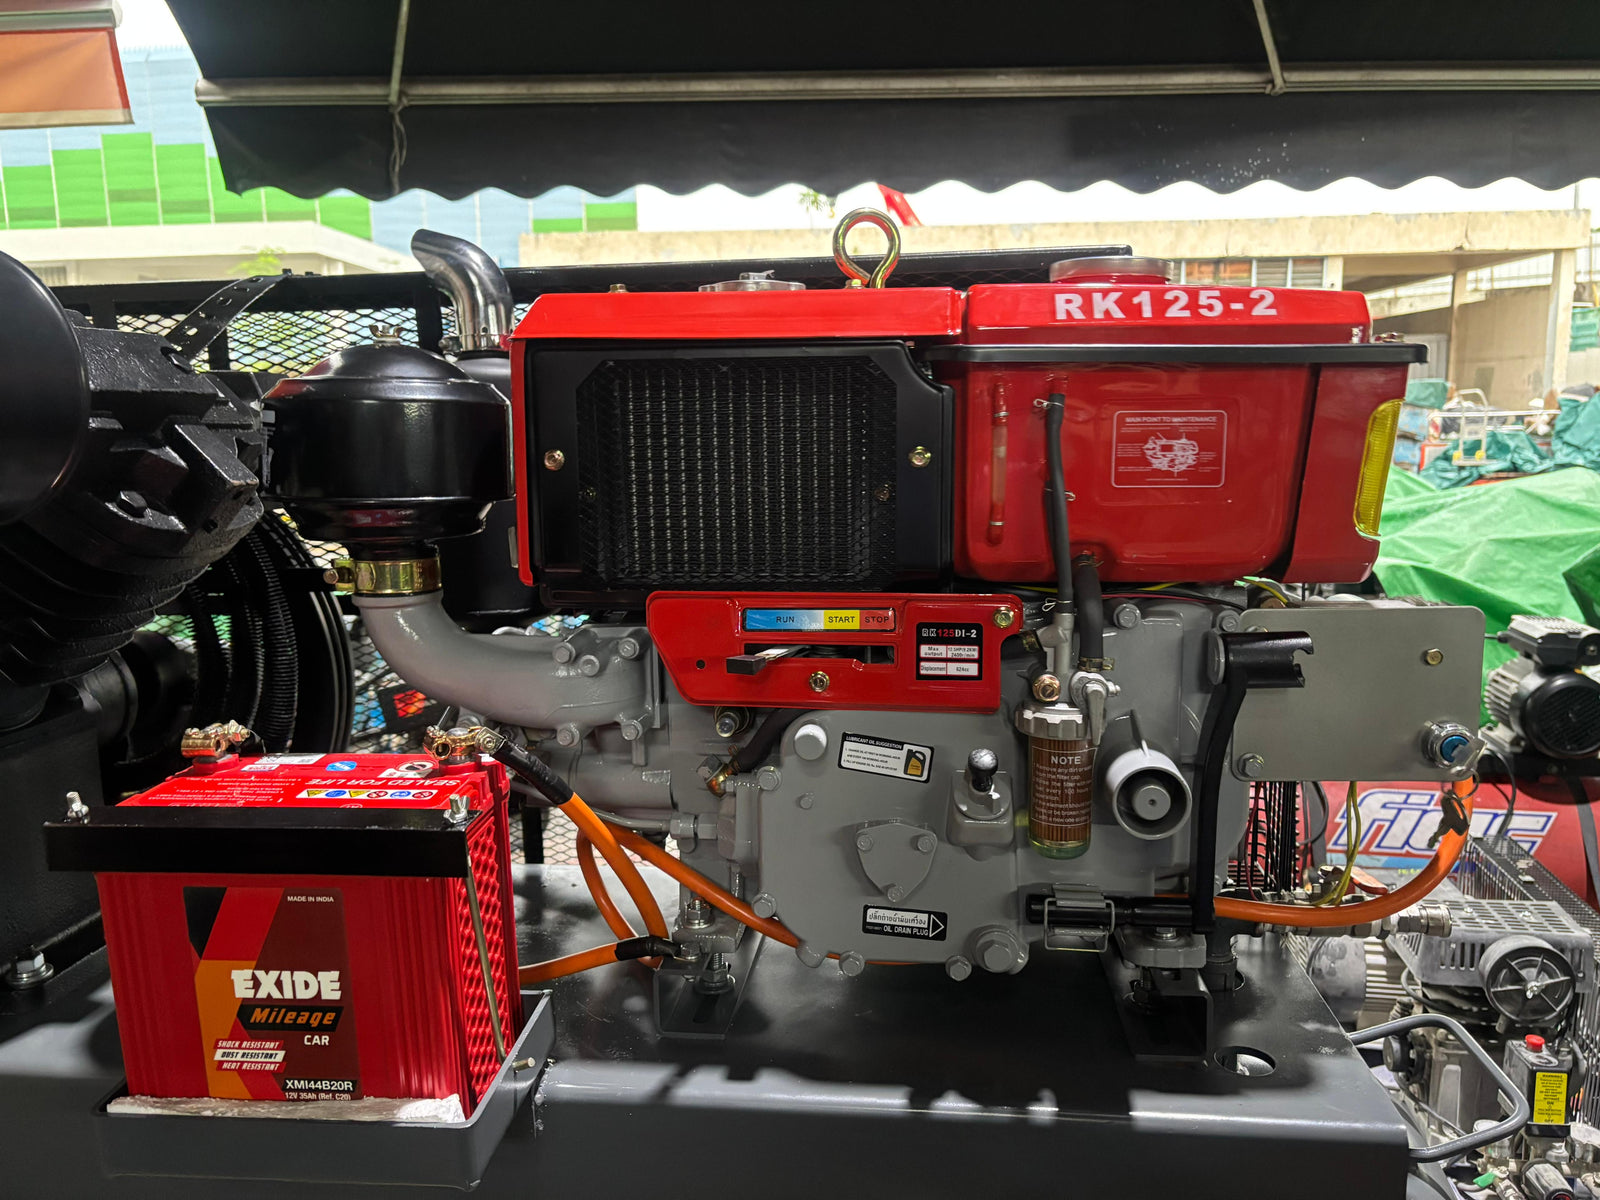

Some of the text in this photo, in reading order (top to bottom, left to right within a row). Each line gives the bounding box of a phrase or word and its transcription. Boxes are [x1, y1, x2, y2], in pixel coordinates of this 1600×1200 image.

[1054, 289, 1278, 320] RK125-2
[865, 616, 889, 624] STOP
[845, 736, 869, 744] LUBRICANT
[876, 740, 902, 749] SUGGESTION
[1051, 756, 1081, 765] NOTE
[883, 925, 893, 933] OIL
[894, 926, 912, 935] DRAIN
[912, 928, 929, 936] PLUG
[231, 969, 342, 1000] EXIDE
[250, 1008, 336, 1028] Mileage
[217, 1040, 280, 1049] SHOCK RESISTANT
[304, 1035, 330, 1046] CAR
[221, 1051, 279, 1060] DUST RESISTANT
[222, 1062, 280, 1071] HEAT RESISTANT
[285, 1079, 354, 1091] XMI44B20R
[285, 1092, 352, 1101] 12V 35Ah (Ref. C20)
